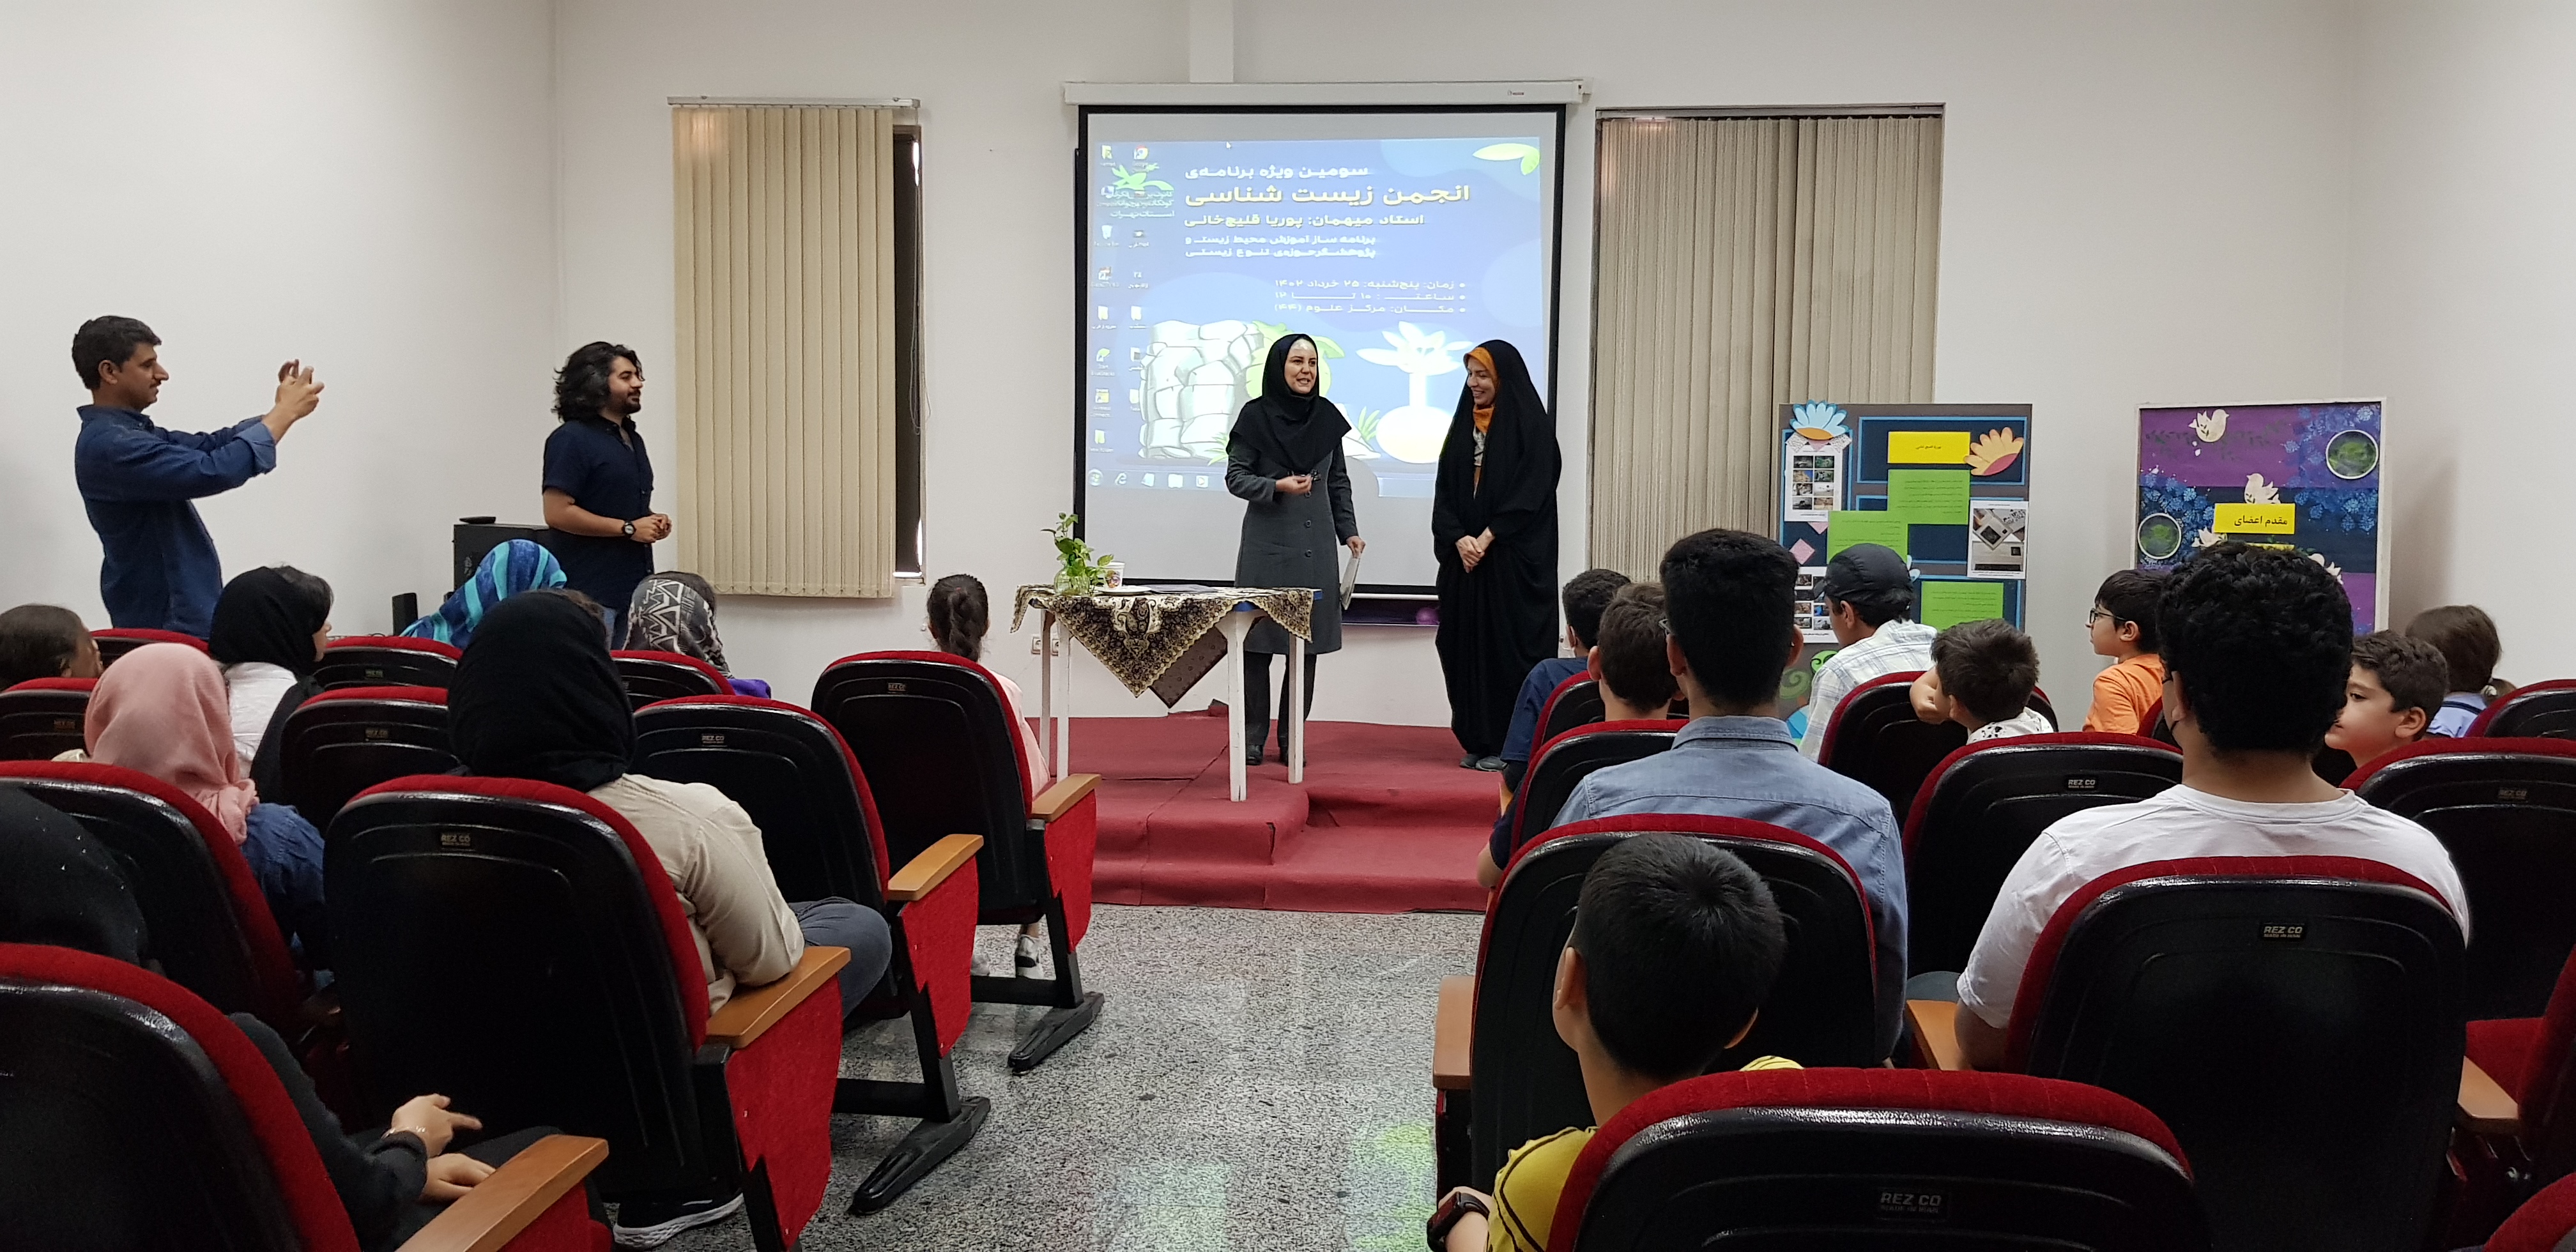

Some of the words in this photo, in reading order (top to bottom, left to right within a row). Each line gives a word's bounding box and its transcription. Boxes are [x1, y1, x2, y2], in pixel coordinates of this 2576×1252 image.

[1259, 164, 1294, 179] ویژه
[1298, 165, 1368, 179] سومین
[1184, 185, 1283, 206] شناسی
[1291, 185, 1373, 206] زیست
[1383, 185, 1469, 206] انجمن
[1265, 215, 1303, 229] پوریا
[1308, 215, 1373, 227] میهمان:
[1379, 215, 1425, 225] استاد
[1233, 235, 1266, 245] محیط
[1269, 234, 1310, 246] آموزش
[1312, 236, 1338, 246] ساز
[1340, 235, 1376, 246] برنامه
[1184, 247, 1233, 257] زیستی
[1236, 247, 1269, 257] تنوع
[1307, 279, 1340, 289] خرداد
[1423, 280, 1455, 289] زمان:
[1306, 305, 1344, 314] علوم
[1347, 305, 1386, 314] مرکز
[2234, 515, 2263, 526] اعضای
[2265, 516, 2288, 527] مقدم
[2263, 926, 2286, 934] REZ
[1880, 1192, 1915, 1205] REZ
[1918, 1195, 1942, 1206] CO
